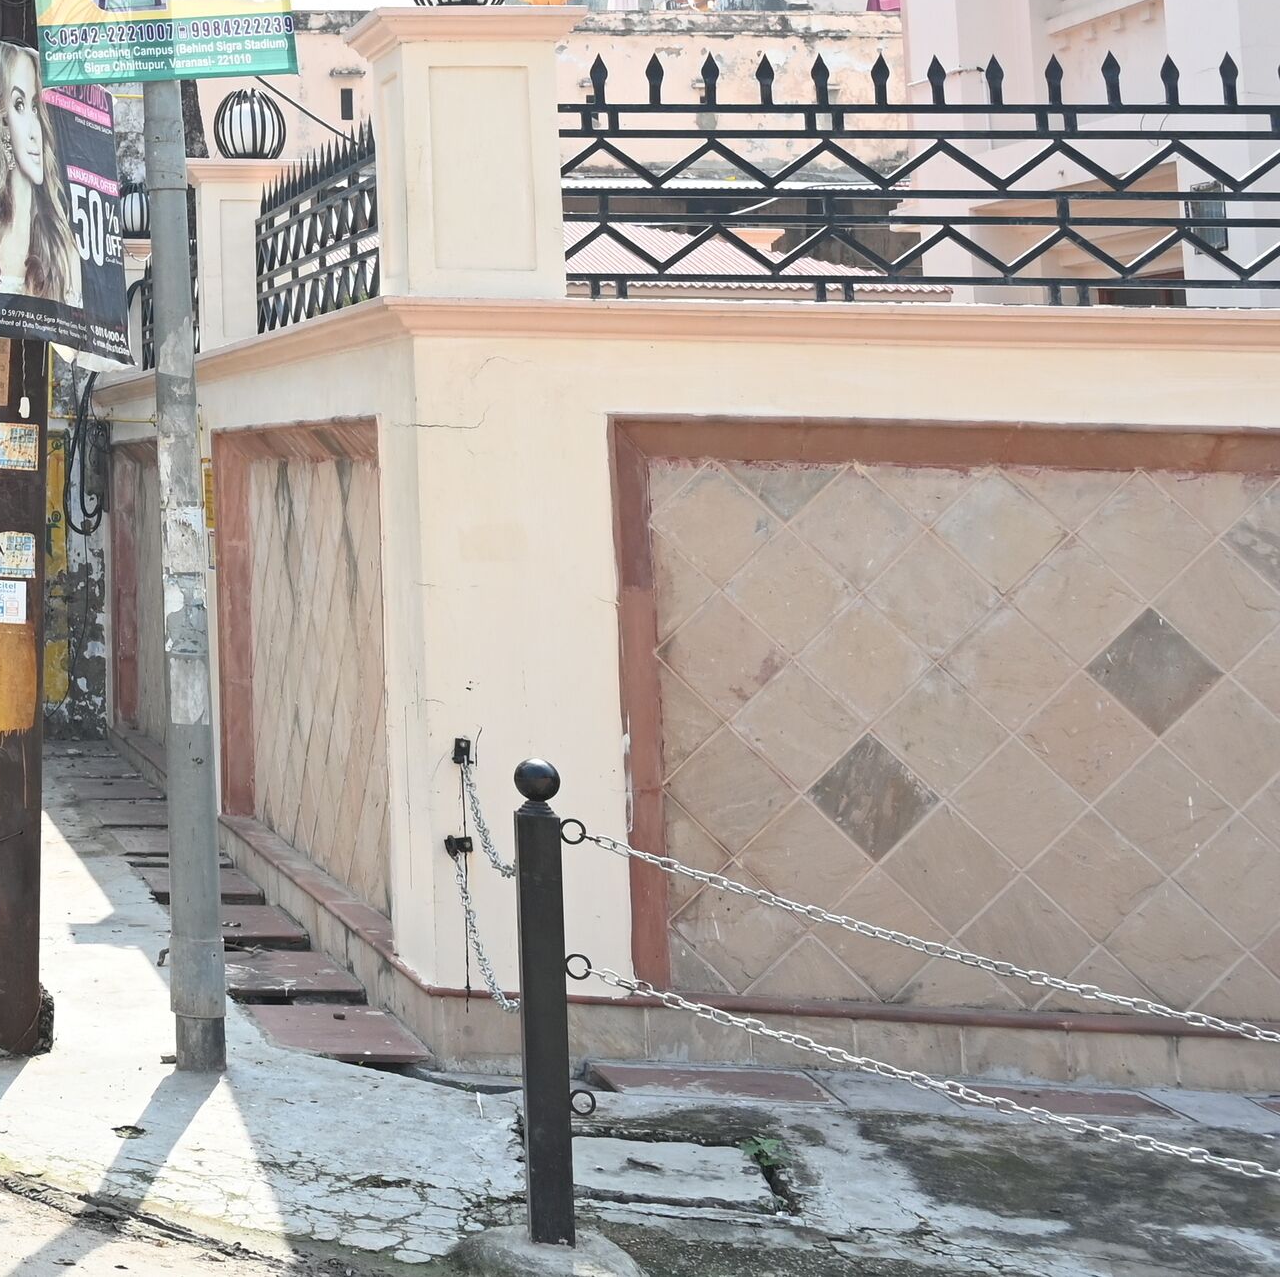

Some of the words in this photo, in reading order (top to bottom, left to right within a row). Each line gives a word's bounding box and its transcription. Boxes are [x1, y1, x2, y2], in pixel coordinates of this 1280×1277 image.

[59, 23, 173, 45] 0542-2221007
[192, 16, 293, 38] 9984222239
[45, 50, 82, 61] Current
[84, 48, 131, 60] Coaching
[133, 45, 173, 57] Campus
[176, 43, 214, 56] (Behind
[216, 41, 242, 53] Sigra
[244, 39, 288, 51] Stadium)
[84, 62, 110, 74] Sigra
[217, 54, 251, 65] 221010
[100, 179, 118, 194] OFFER
[70, 183, 104, 267] 50
[105, 202, 119, 234] %
[106, 233, 122, 258] OFF
